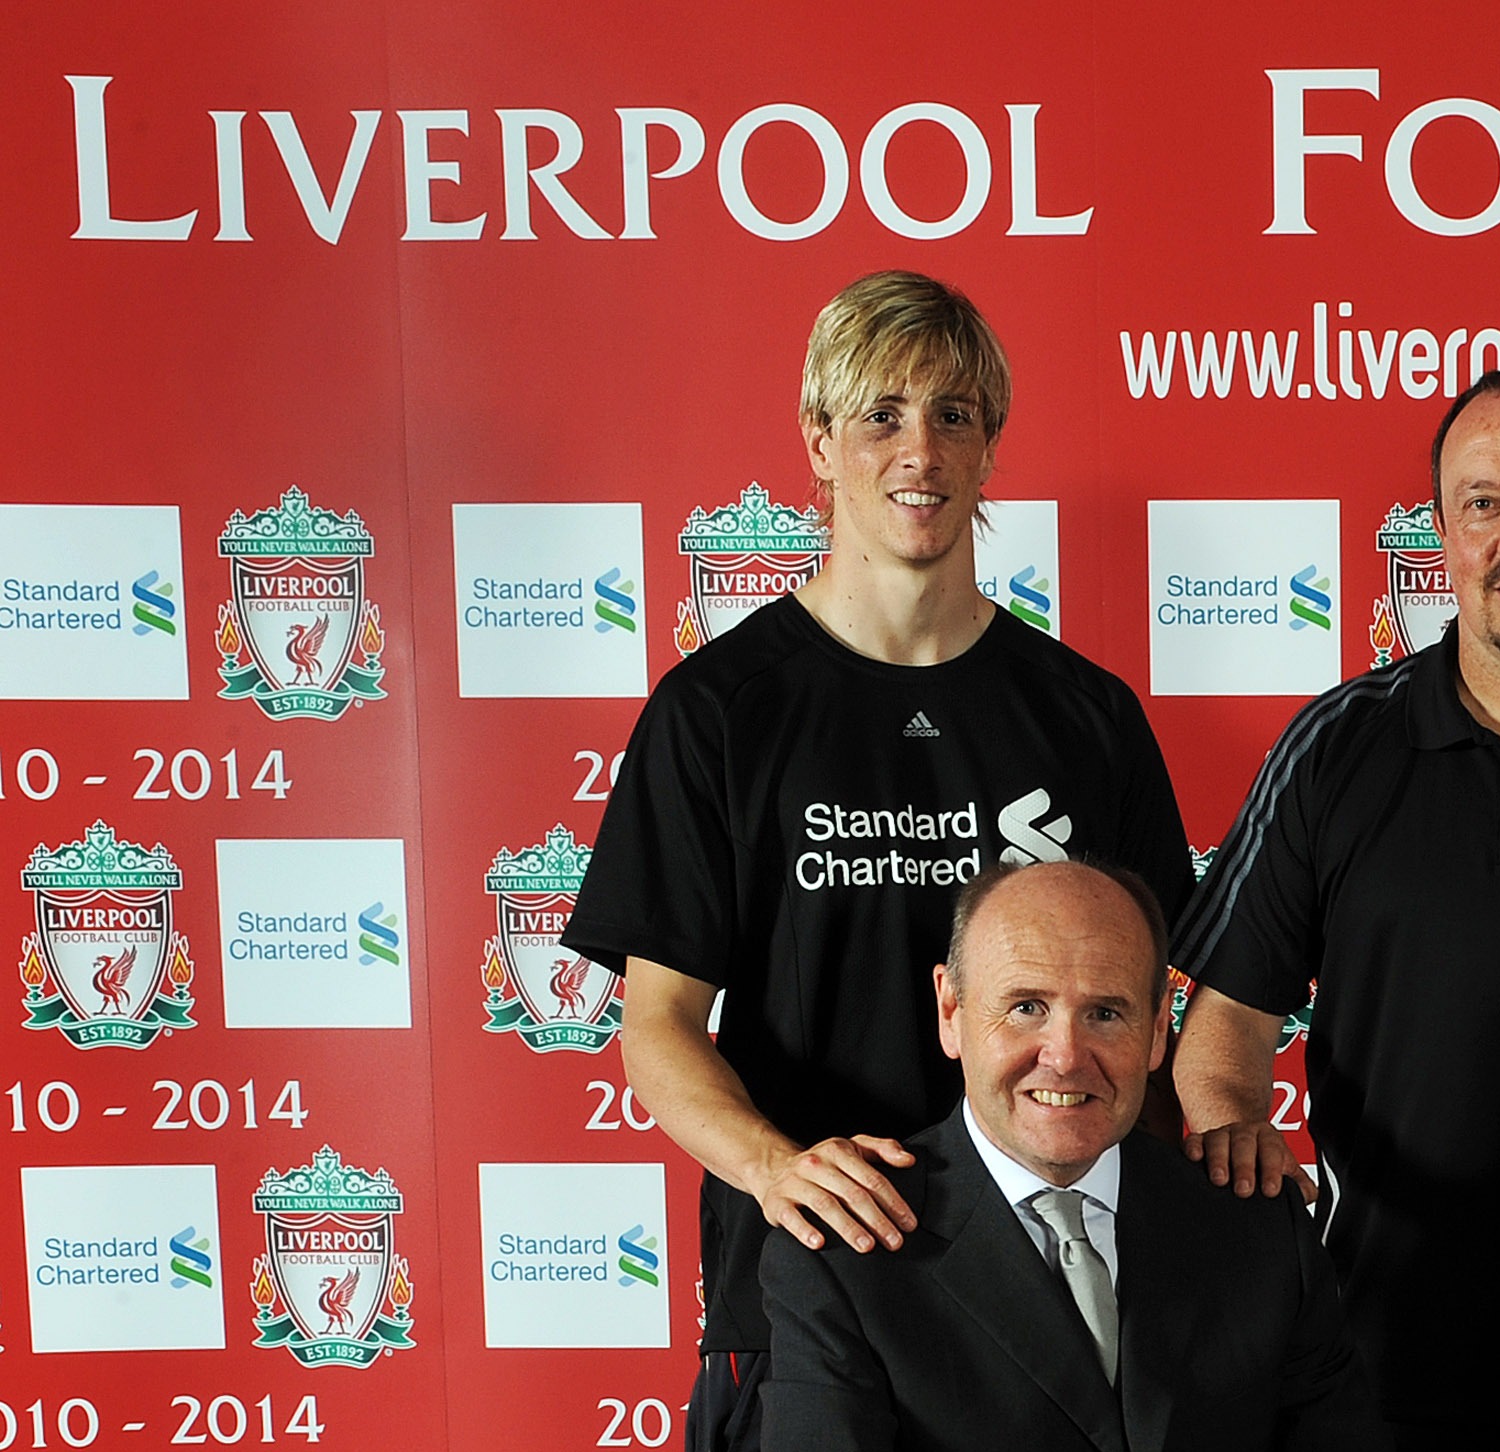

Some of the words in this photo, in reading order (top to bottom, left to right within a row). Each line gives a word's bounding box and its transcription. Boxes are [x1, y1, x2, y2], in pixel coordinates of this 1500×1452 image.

[64, 75, 1094, 245] LIVERPOOL
[222, 542, 259, 552] YOU'LL
[261, 542, 297, 552] NEVER
[297, 542, 331, 552] WALK
[332, 542, 370, 553] ALONE
[682, 539, 719, 549] YOU'LL
[720, 539, 756, 549] NEVER
[756, 539, 790, 549] WALK
[1380, 536, 1417, 546] YOU'LL
[1420, 535, 1442, 546] NEV
[4, 579, 120, 601] Standard
[243, 577, 354, 597] LIVERPOOL
[474, 578, 582, 599] Standard
[1168, 575, 1277, 597] Standard
[249, 601, 314, 612] FOOTBALL
[317, 601, 349, 612] CLUB
[1404, 595, 1456, 606] FOOTBA
[0, 607, 121, 629] Chartered
[465, 606, 583, 627] Chartered
[1158, 604, 1277, 625] Chartered
[903, 727, 940, 737] adidas
[134, 749, 292, 800] 2014
[804, 802, 978, 842] Standard
[795, 847, 981, 891] Chartered
[25, 875, 64, 885] YOU'LL
[65, 875, 103, 885] NEVER
[103, 875, 138, 885] WALK
[139, 875, 179, 885] ALONE
[488, 879, 525, 889] YOU'LL
[526, 879, 562, 889] NEVER
[47, 909, 163, 928] LIVERPOOL
[238, 912, 346, 932] Standard
[508, 912, 573, 932] LIVER
[54, 933, 121, 944] FOOTBALL
[124, 933, 158, 943] CLUB
[230, 939, 347, 960] Chartered
[6, 1082, 79, 1131] 10
[153, 1079, 308, 1129] 2014
[585, 1080, 657, 1131] 20
[257, 1198, 293, 1208] YOU'LL
[294, 1199, 329, 1209] NEVER
[329, 1199, 362, 1209] WALK
[362, 1199, 399, 1209] ALONE
[45, 1237, 157, 1258] Standard
[277, 1232, 384, 1251] LIVERPOOL
[500, 1234, 606, 1254] Standard
[283, 1255, 345, 1265] FOOTBALL
[348, 1255, 379, 1265] CLUB
[37, 1264, 159, 1285] Chartered
[491, 1261, 607, 1281] Chartered
[171, 1394, 325, 1443] 2014
[596, 1398, 690, 1448] 20
